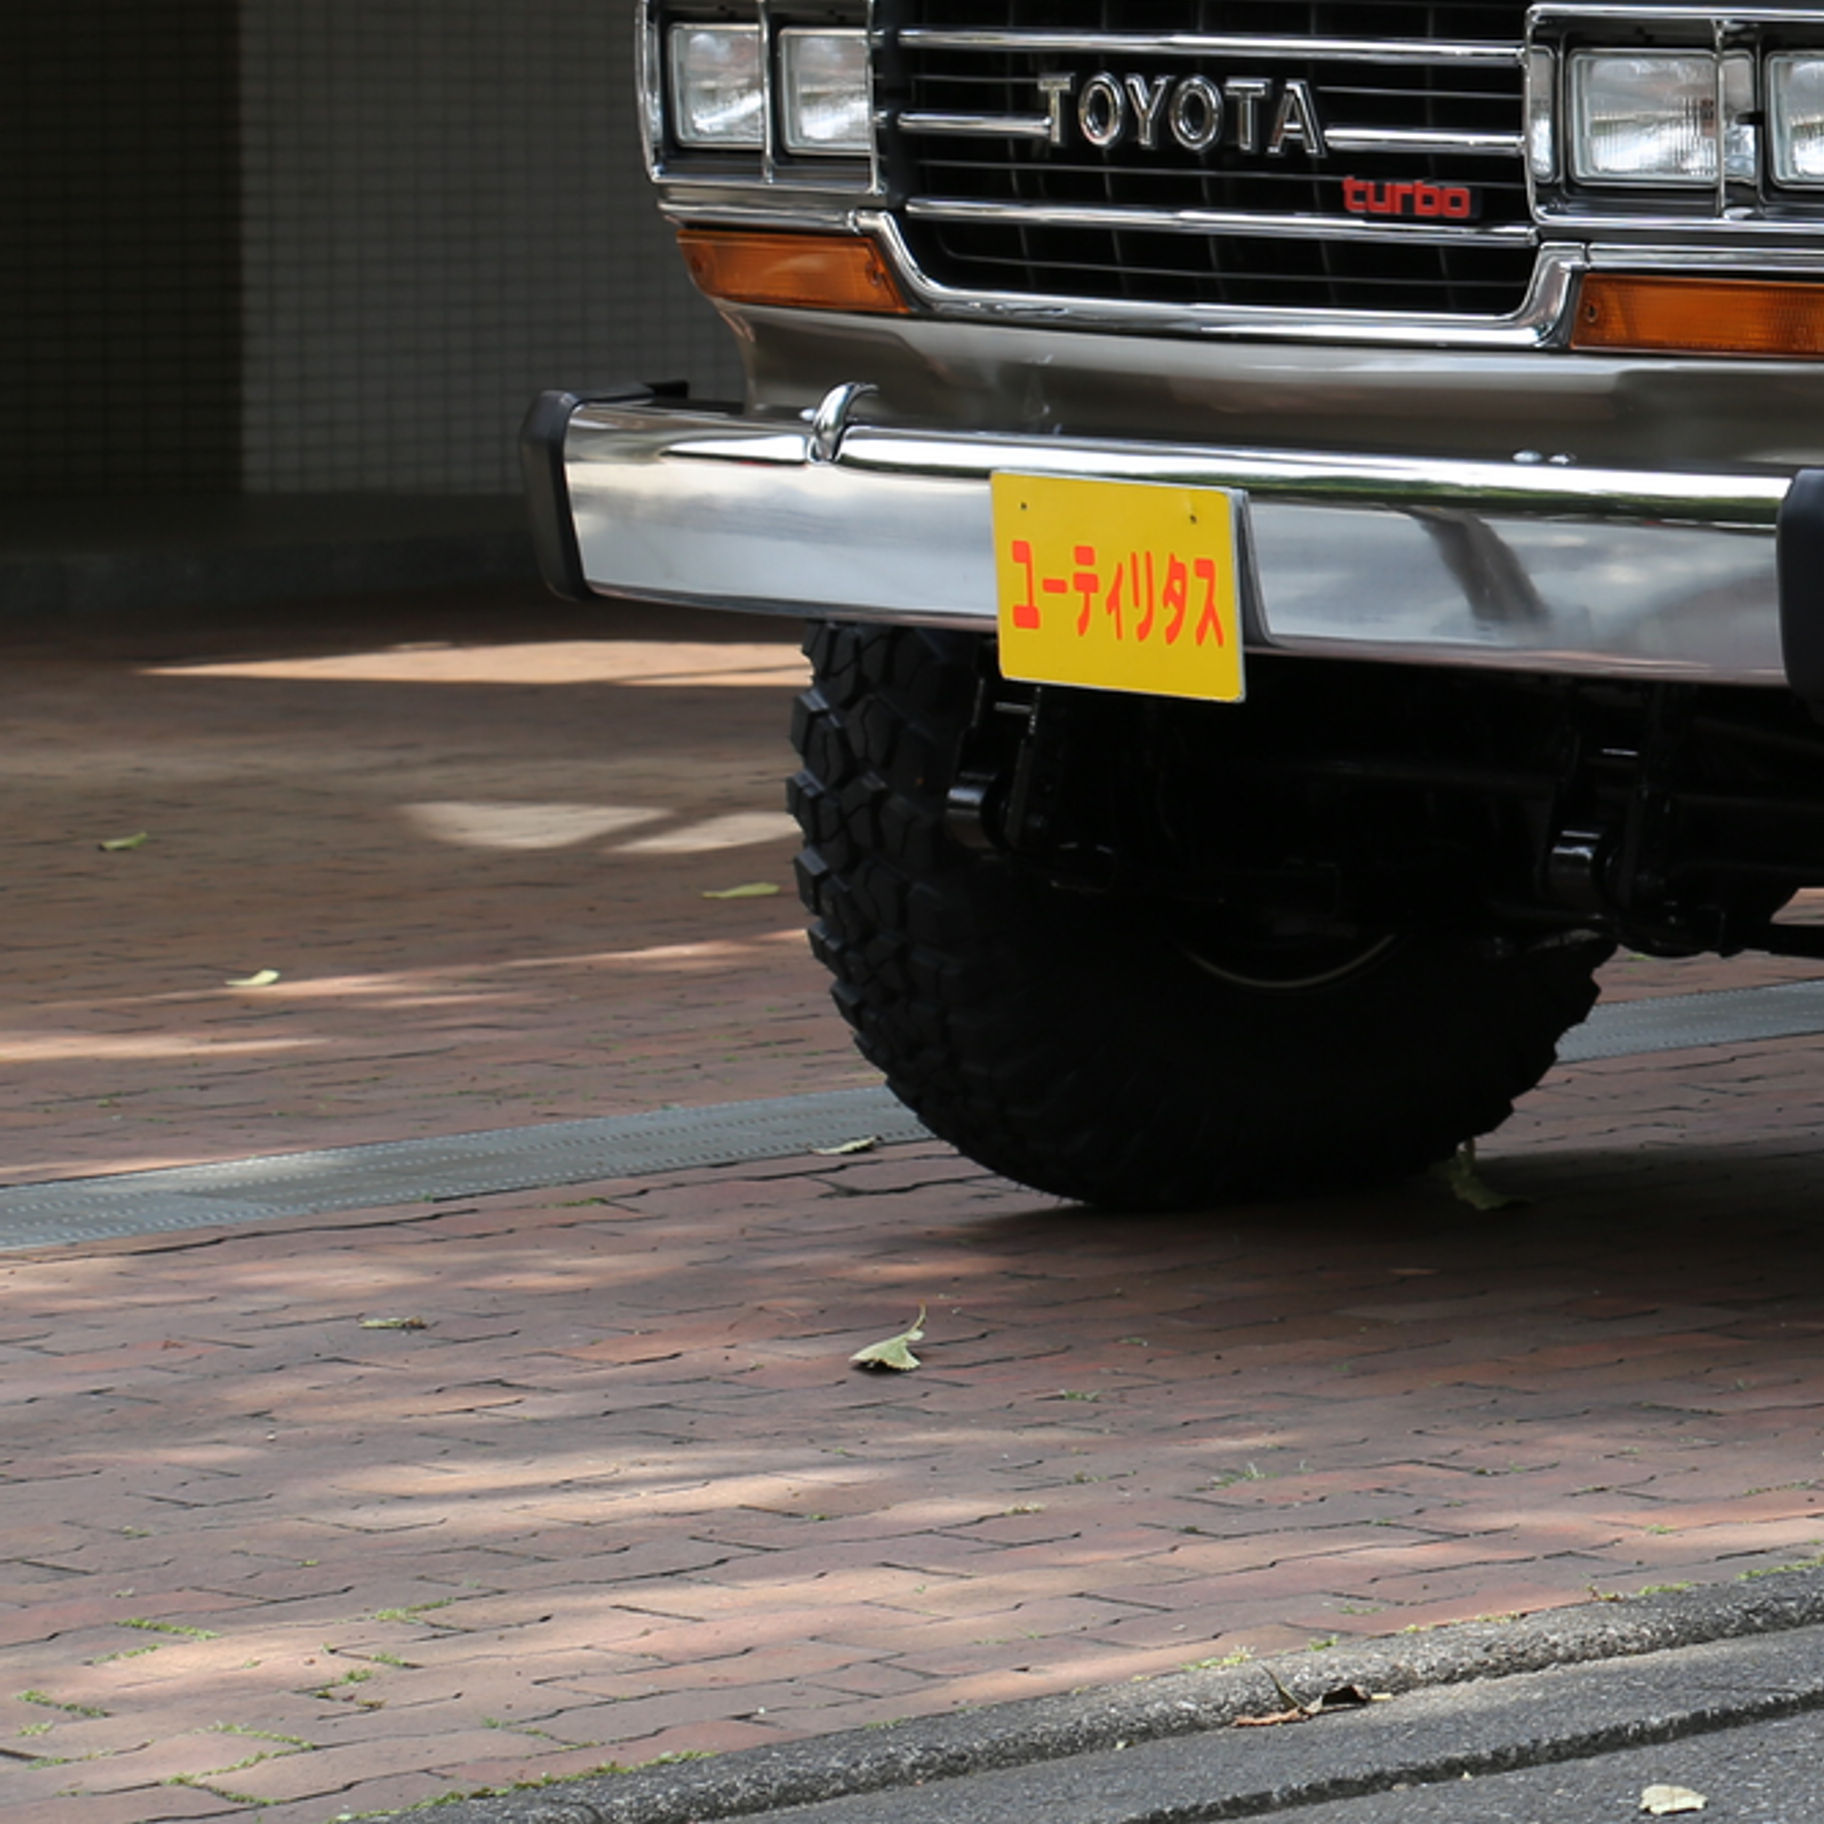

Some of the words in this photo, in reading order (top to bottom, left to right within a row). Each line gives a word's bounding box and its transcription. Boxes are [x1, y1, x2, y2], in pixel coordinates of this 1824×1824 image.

[1037, 70, 1327, 158] TOYOTA
[1342, 176, 1472, 219] turbo
[1011, 539, 1225, 647] ユーティリタス
